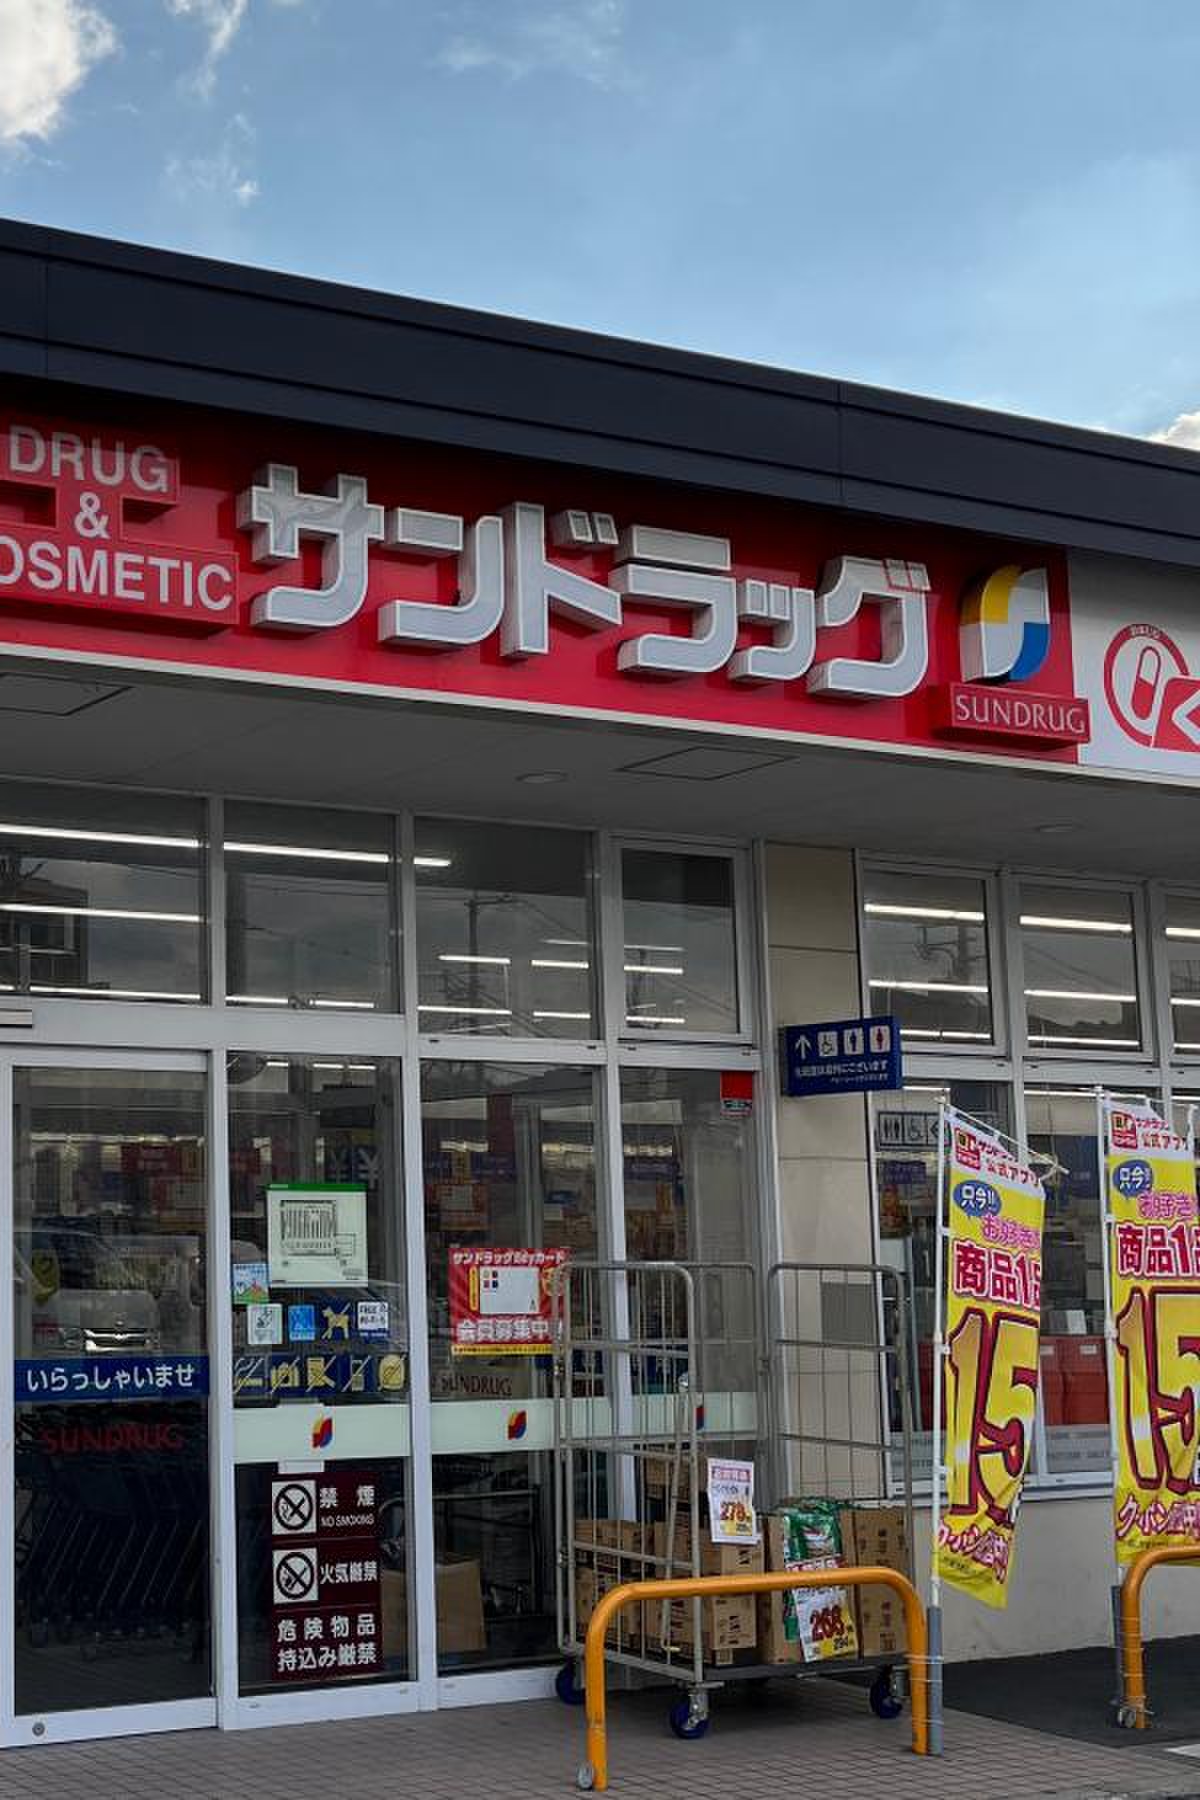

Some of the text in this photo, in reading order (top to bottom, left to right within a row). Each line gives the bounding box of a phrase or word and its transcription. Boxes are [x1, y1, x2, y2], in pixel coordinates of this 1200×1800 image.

[8, 424, 170, 494] DRUG
[74, 492, 110, 540] &
[242, 463, 932, 701] サンドラッグ
[955, 694, 1086, 734] SUNDRUG
[1117, 1223, 1200, 1277] 商品1
[955, 1241, 1040, 1309] 商品1
[26, 1364, 195, 1393] いらっしゃいませ
[320, 1485, 375, 1508] 禁煙
[321, 1516, 335, 1528] NO
[320, 1561, 378, 1585] 火気厳禁
[277, 1613, 376, 1643] 危険物品
[277, 1643, 377, 1673] 持込み厳禁
